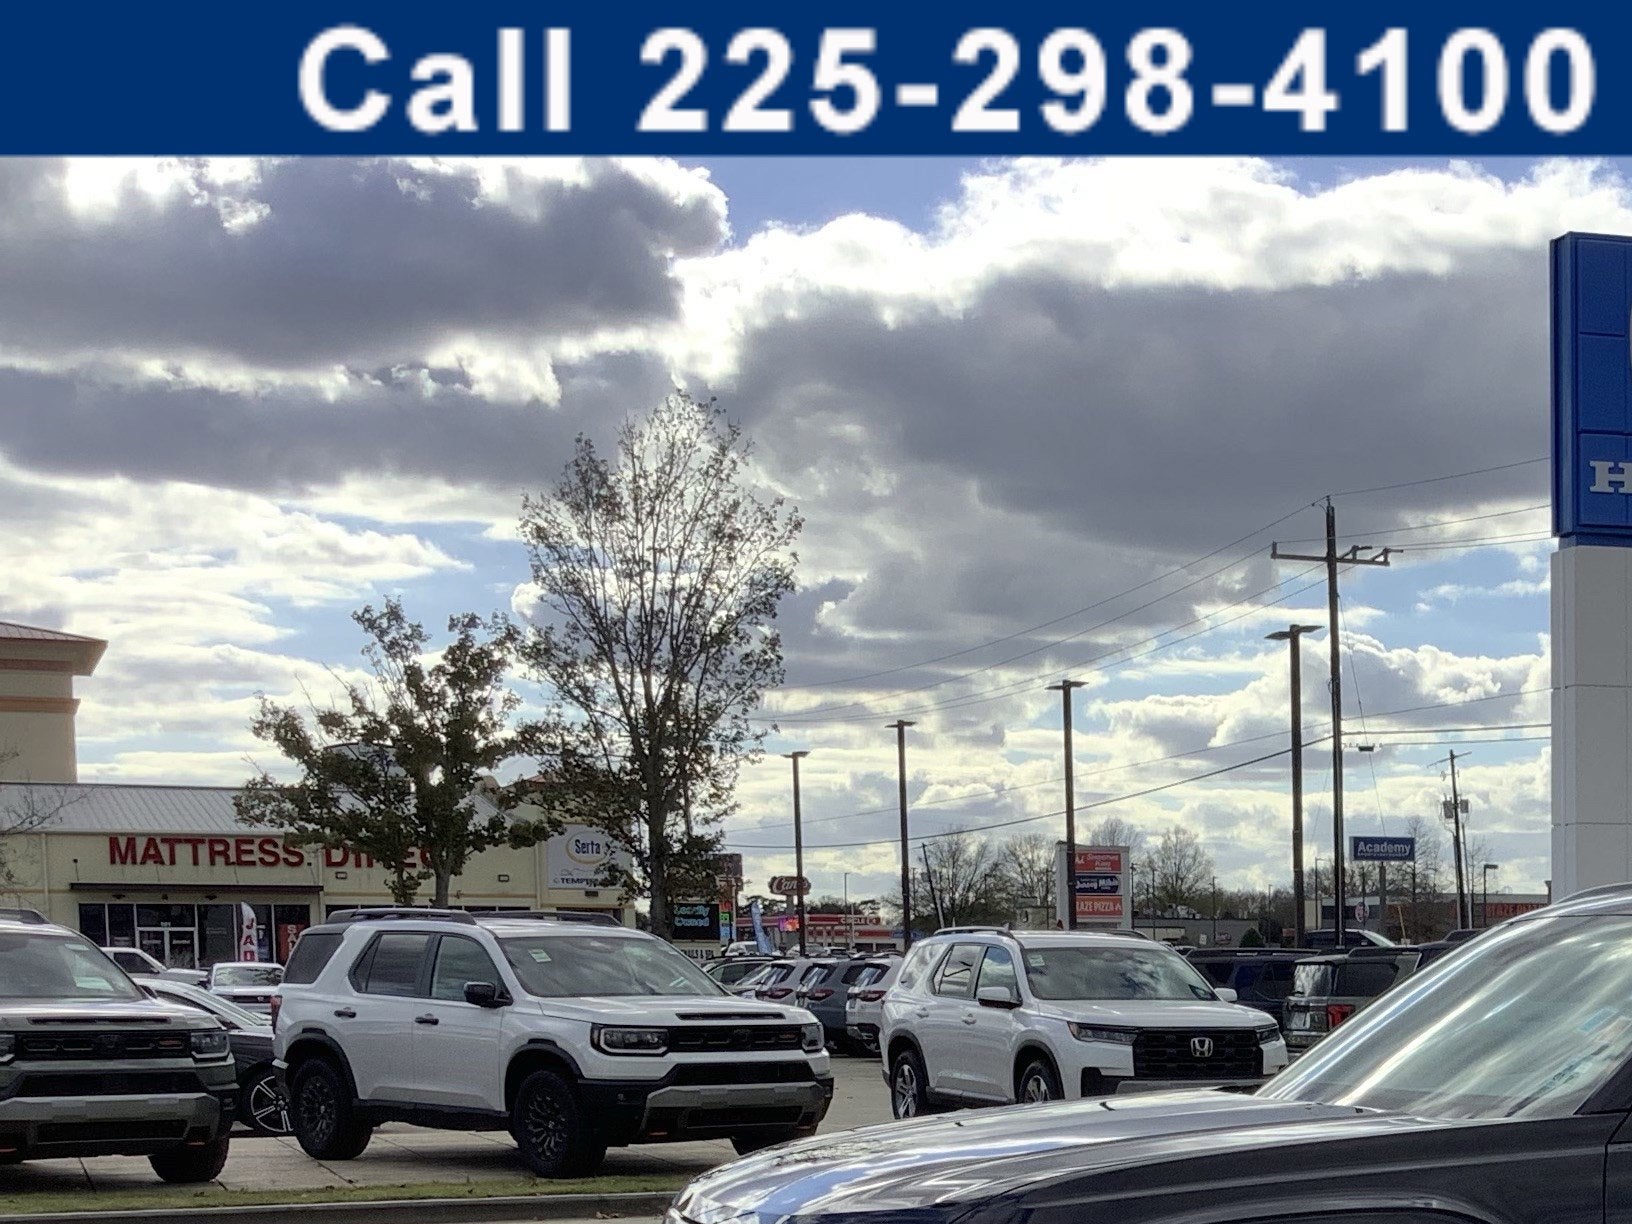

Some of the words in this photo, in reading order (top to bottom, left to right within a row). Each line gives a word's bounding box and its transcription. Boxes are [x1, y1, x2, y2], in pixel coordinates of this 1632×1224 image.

[108, 836, 305, 867] MATTRESS
[574, 839, 601, 855] Serta
[1357, 841, 1410, 856] Academy
[1094, 901, 1114, 912] PIZZA
[674, 916, 710, 927] Owned
